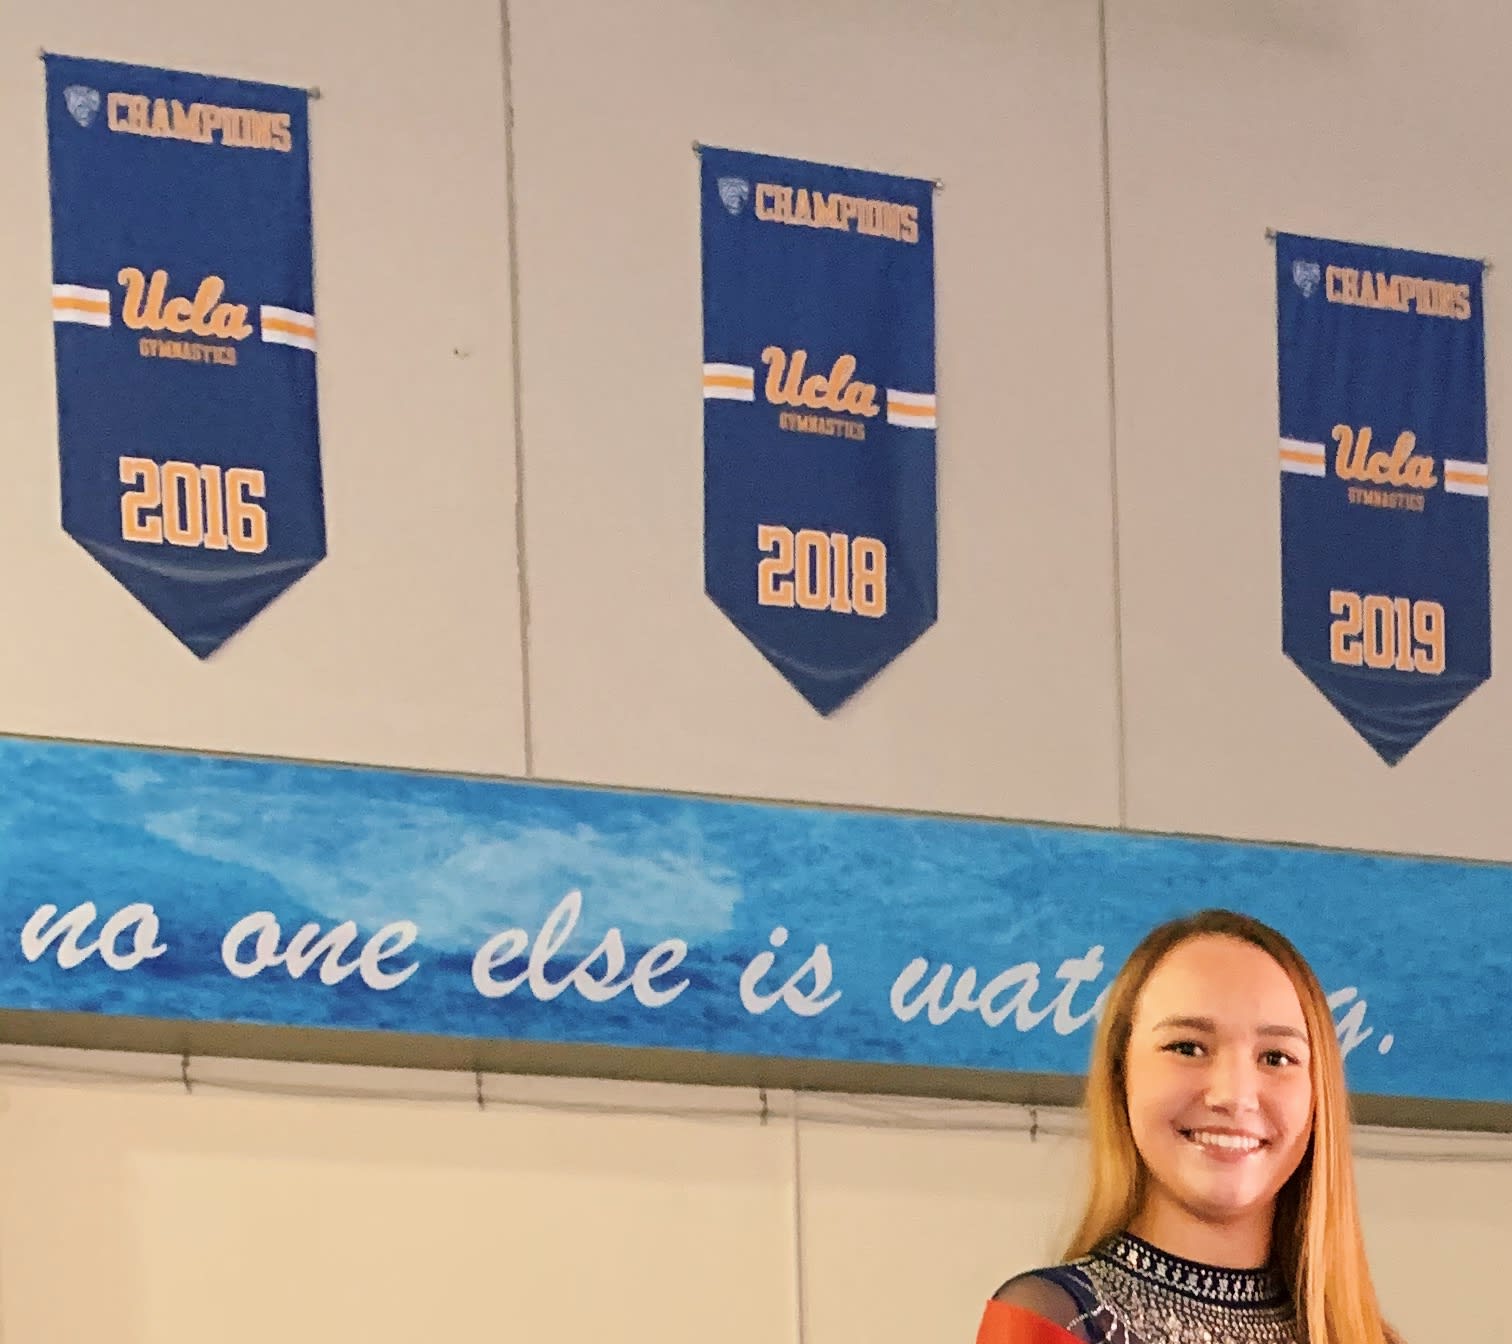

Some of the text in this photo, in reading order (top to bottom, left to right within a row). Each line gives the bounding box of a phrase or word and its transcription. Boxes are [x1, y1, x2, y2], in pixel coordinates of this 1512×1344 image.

[108, 92, 291, 152] CHAMPIONS
[755, 183, 918, 244] CHAMPIONS
[118, 267, 252, 341] Ucla
[1326, 265, 1471, 319] CHAMPIONS
[762, 346, 879, 418] Ucla
[1332, 424, 1438, 489] Ucla
[119, 457, 267, 553] 2016
[758, 525, 887, 618] 2018
[1330, 590, 1446, 675] 2019
[21, 901, 167, 970] no
[221, 911, 420, 991] one
[472, 888, 690, 1009] else
[739, 927, 843, 1016] is
